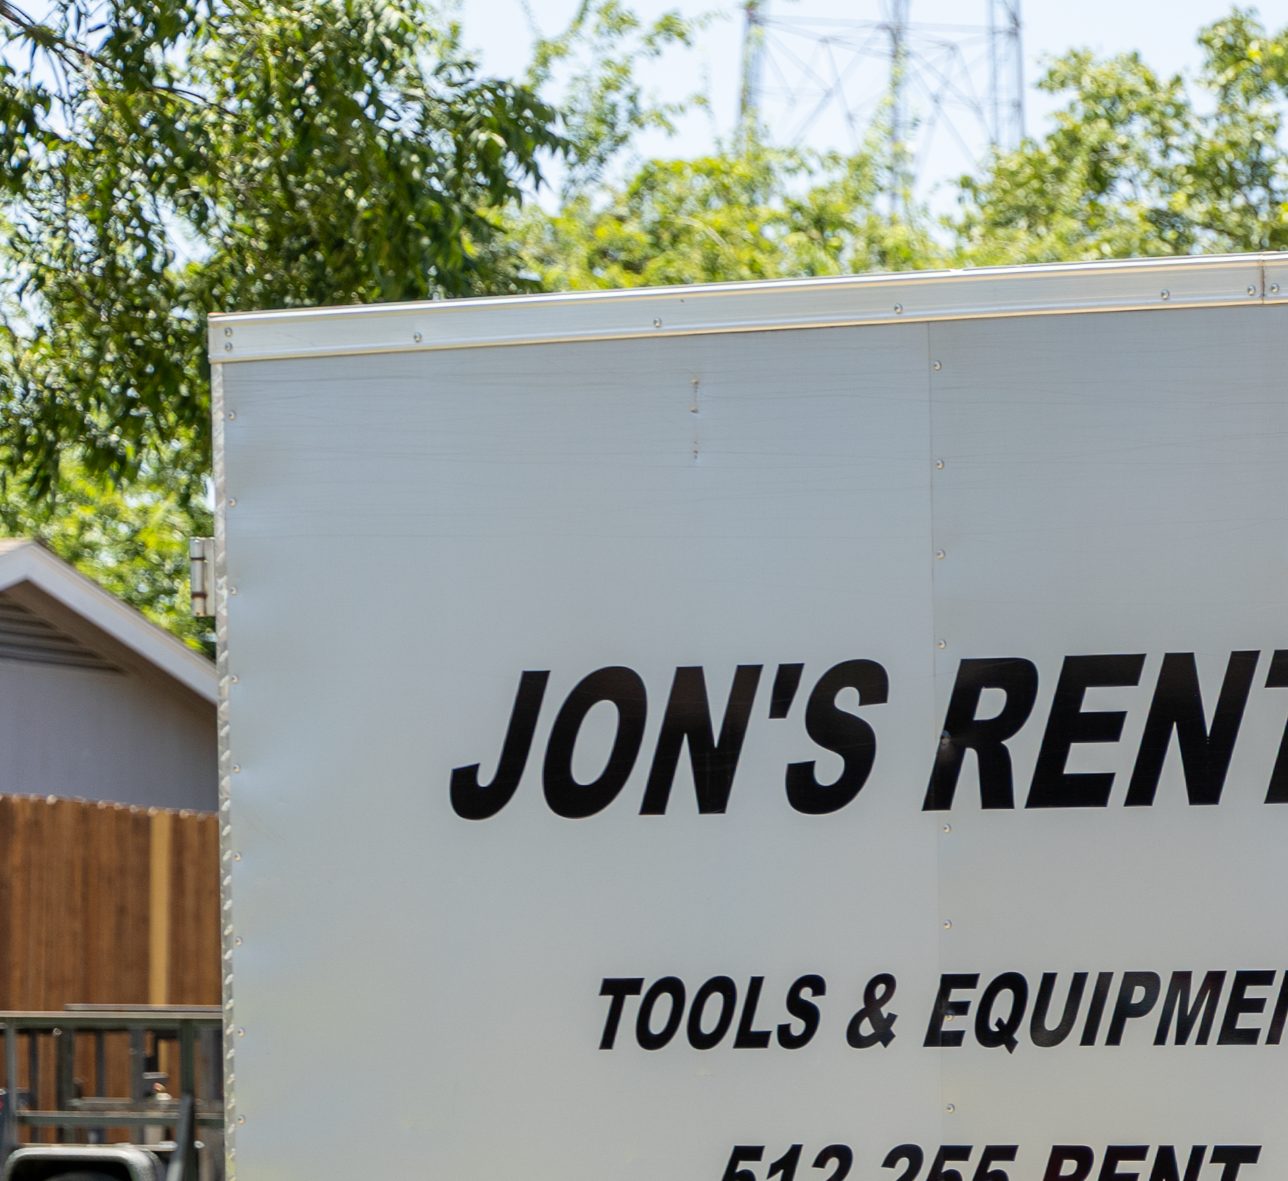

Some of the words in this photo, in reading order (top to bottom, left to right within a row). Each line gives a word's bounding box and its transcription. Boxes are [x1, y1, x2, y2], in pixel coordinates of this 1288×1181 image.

[450, 658, 888, 821] JON'S
[599, 974, 826, 1051] TOOLS
[846, 973, 898, 1049] &
